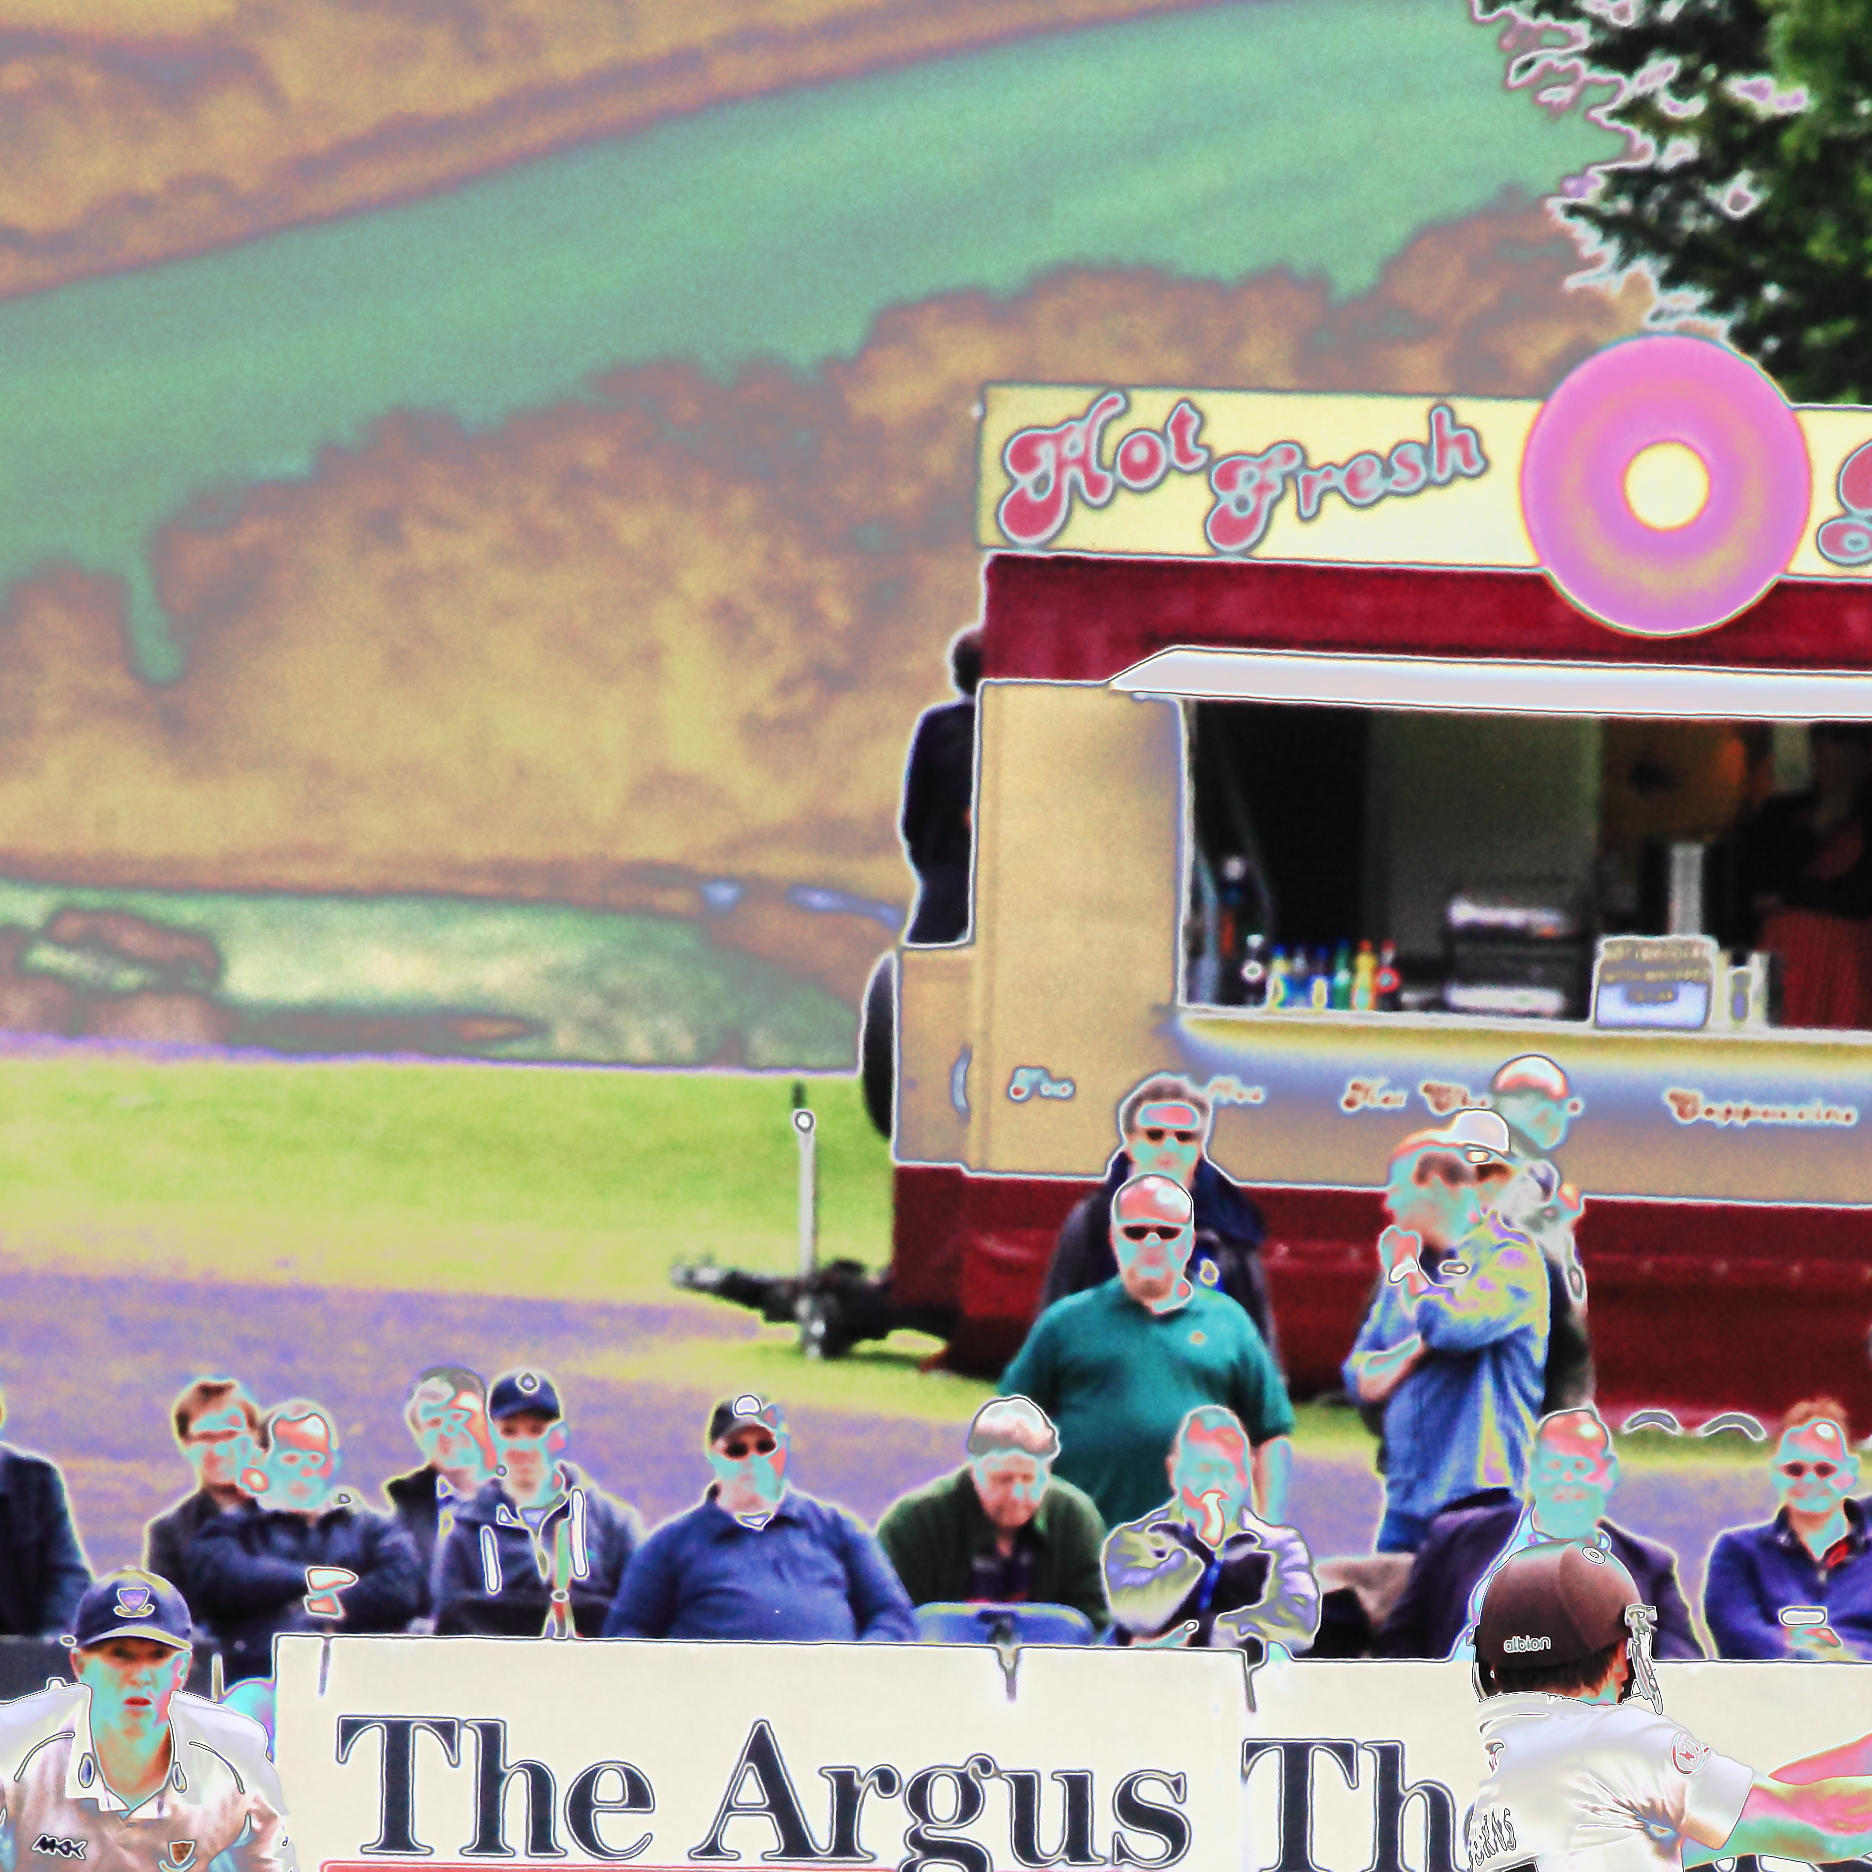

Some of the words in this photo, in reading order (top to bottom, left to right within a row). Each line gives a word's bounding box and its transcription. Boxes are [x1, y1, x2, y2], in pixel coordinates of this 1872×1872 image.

[998, 391, 1208, 547] Hot
[1204, 404, 1489, 555] Fresh
[1503, 1634, 1551, 1653] albion
[336, 1715, 656, 1859] The
